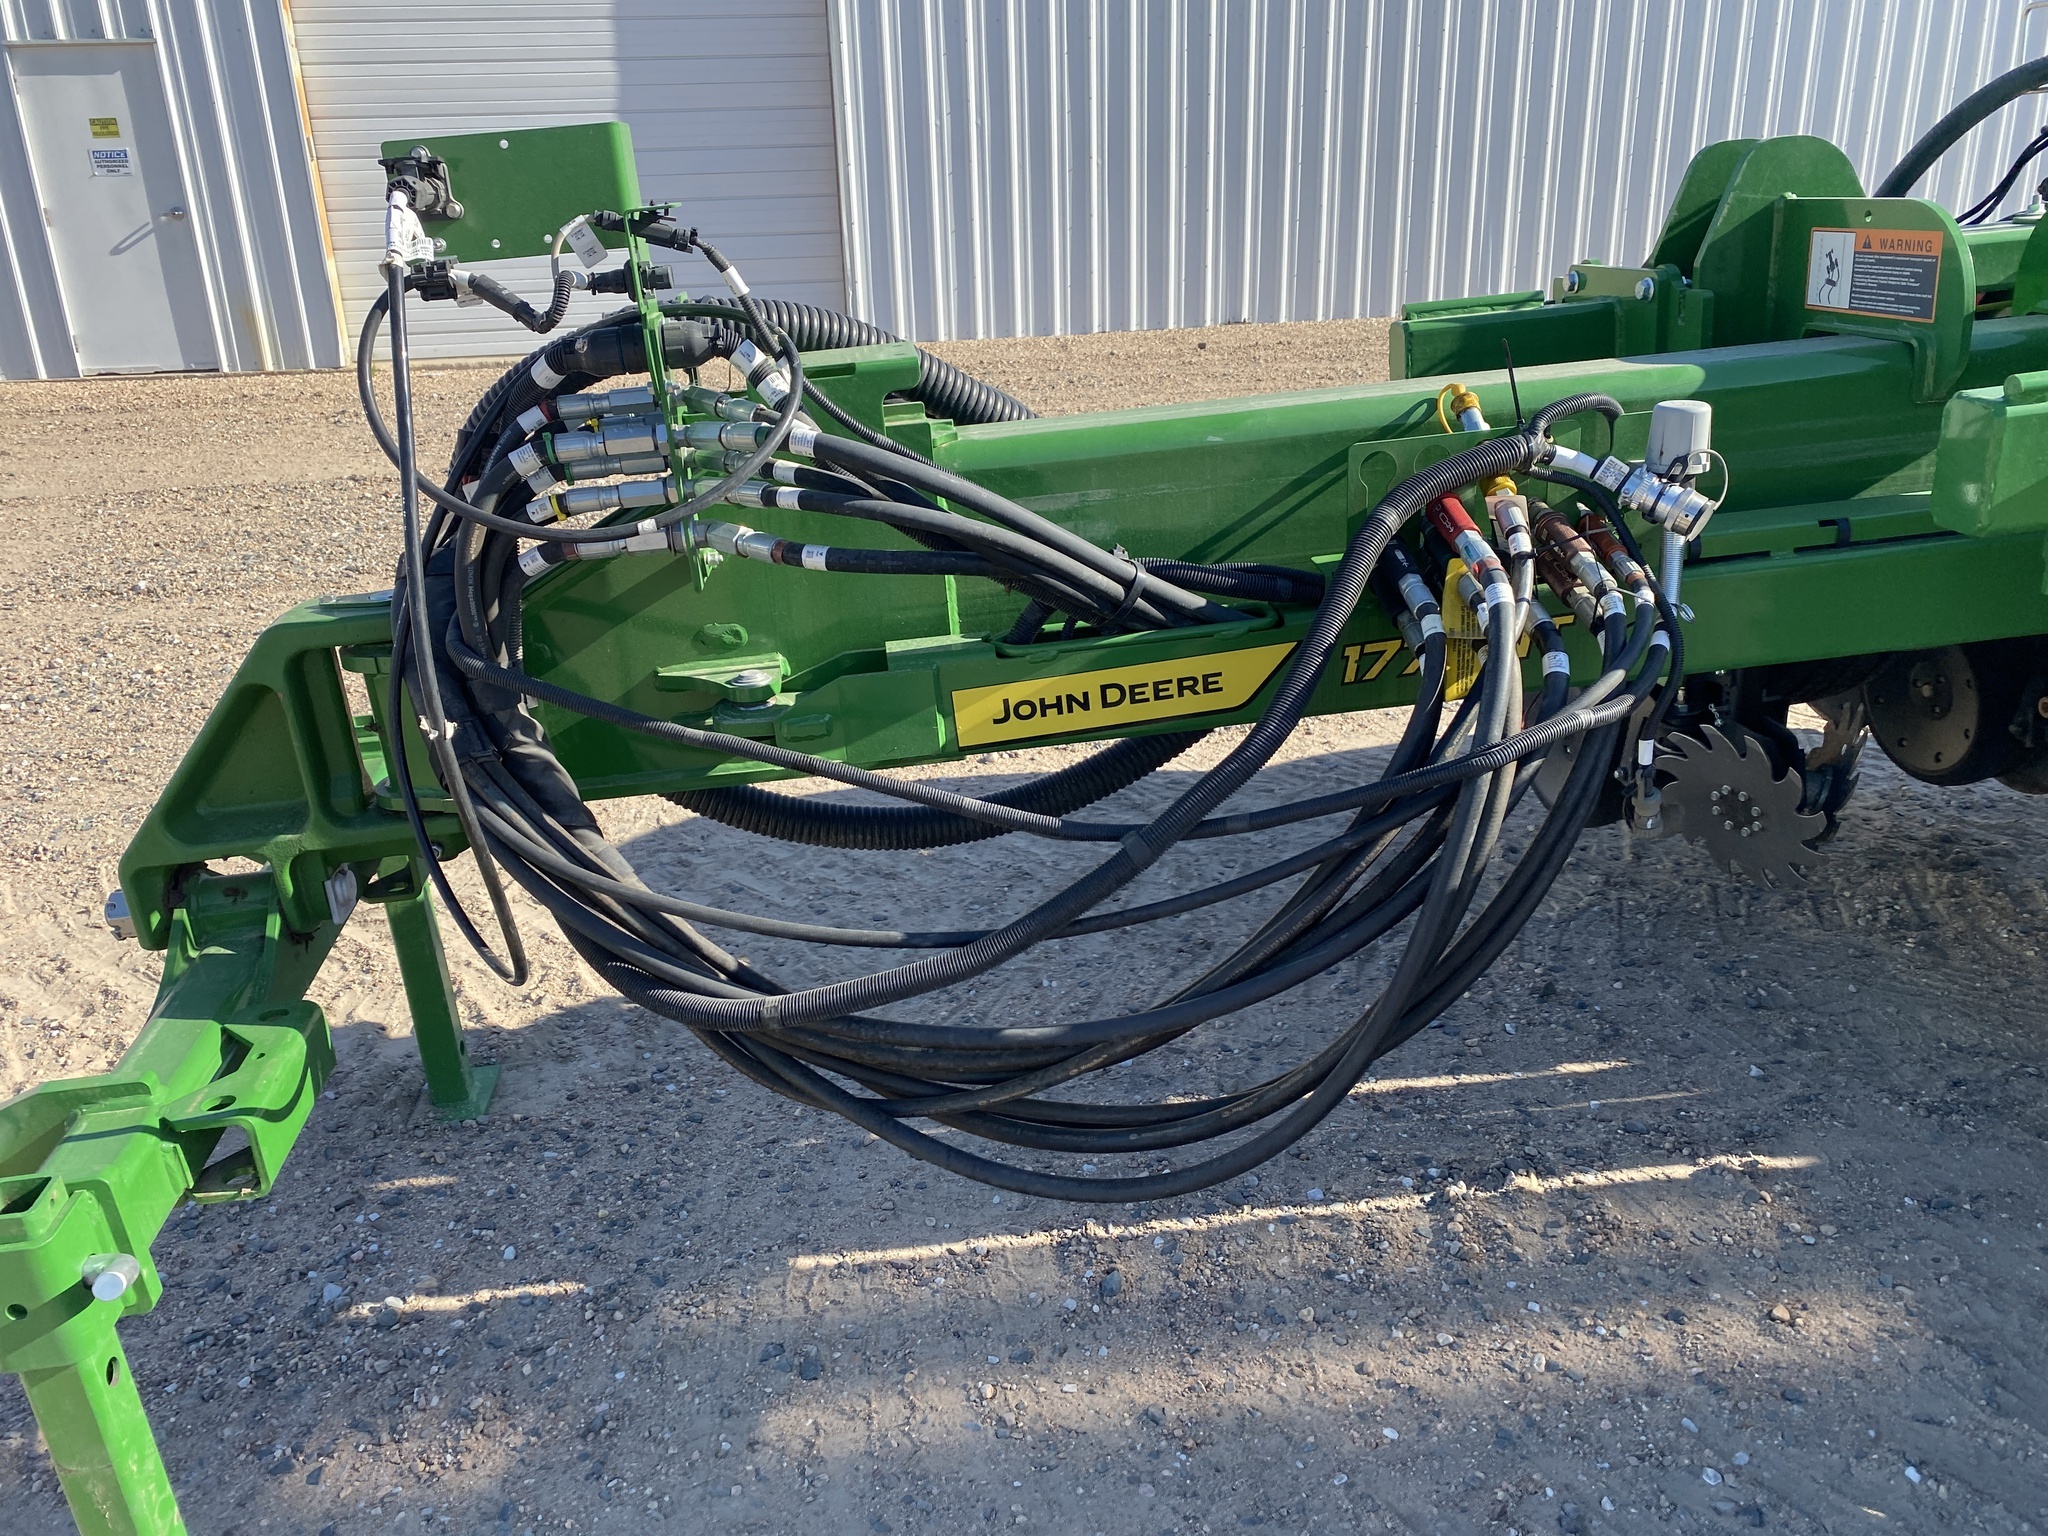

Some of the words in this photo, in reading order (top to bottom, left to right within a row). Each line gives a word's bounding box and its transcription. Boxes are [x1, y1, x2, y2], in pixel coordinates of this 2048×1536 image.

[1880, 238, 1933, 252] WARNING
[992, 691, 1090, 725] JOHN
[1100, 672, 1224, 709] DEERE
